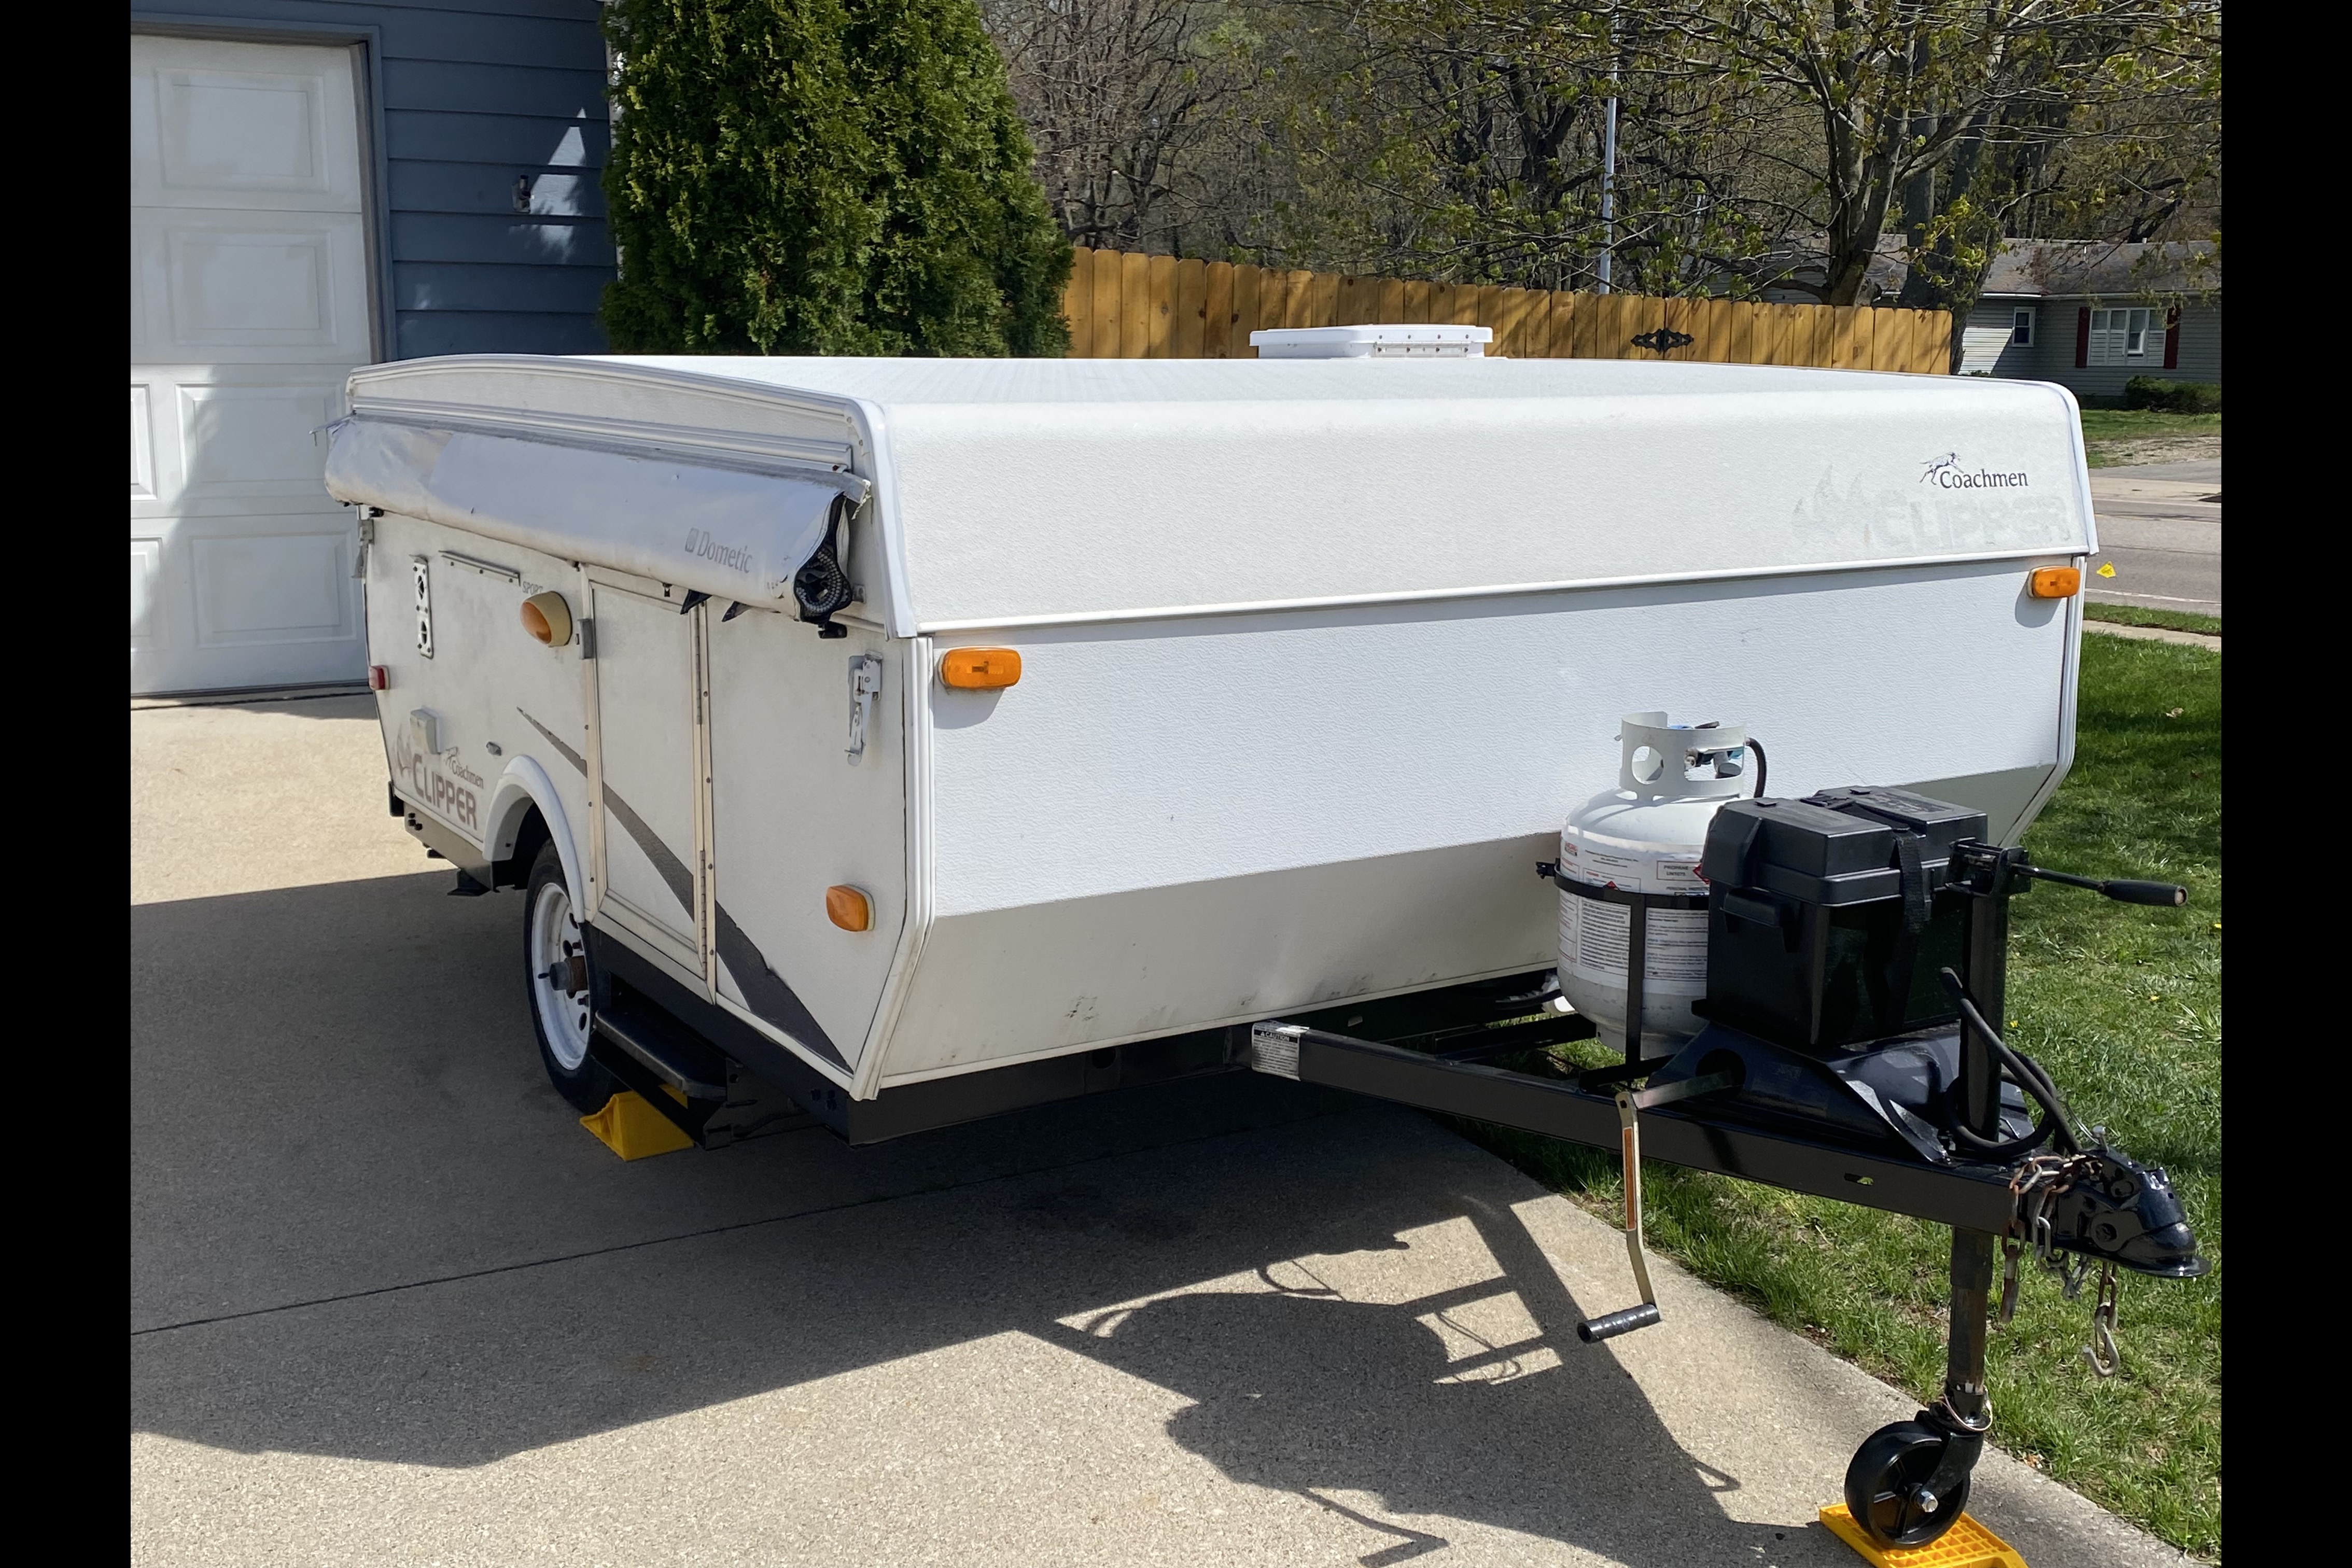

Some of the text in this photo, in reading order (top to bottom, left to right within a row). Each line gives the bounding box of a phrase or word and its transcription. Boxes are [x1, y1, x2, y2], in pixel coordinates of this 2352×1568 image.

[1940, 469, 2028, 488] Coachmen
[697, 531, 752, 573] Dometic
[452, 760, 484, 789] Coachmen
[413, 753, 477, 830] CLIPPER
[1265, 1032, 1290, 1041] CAUTION
